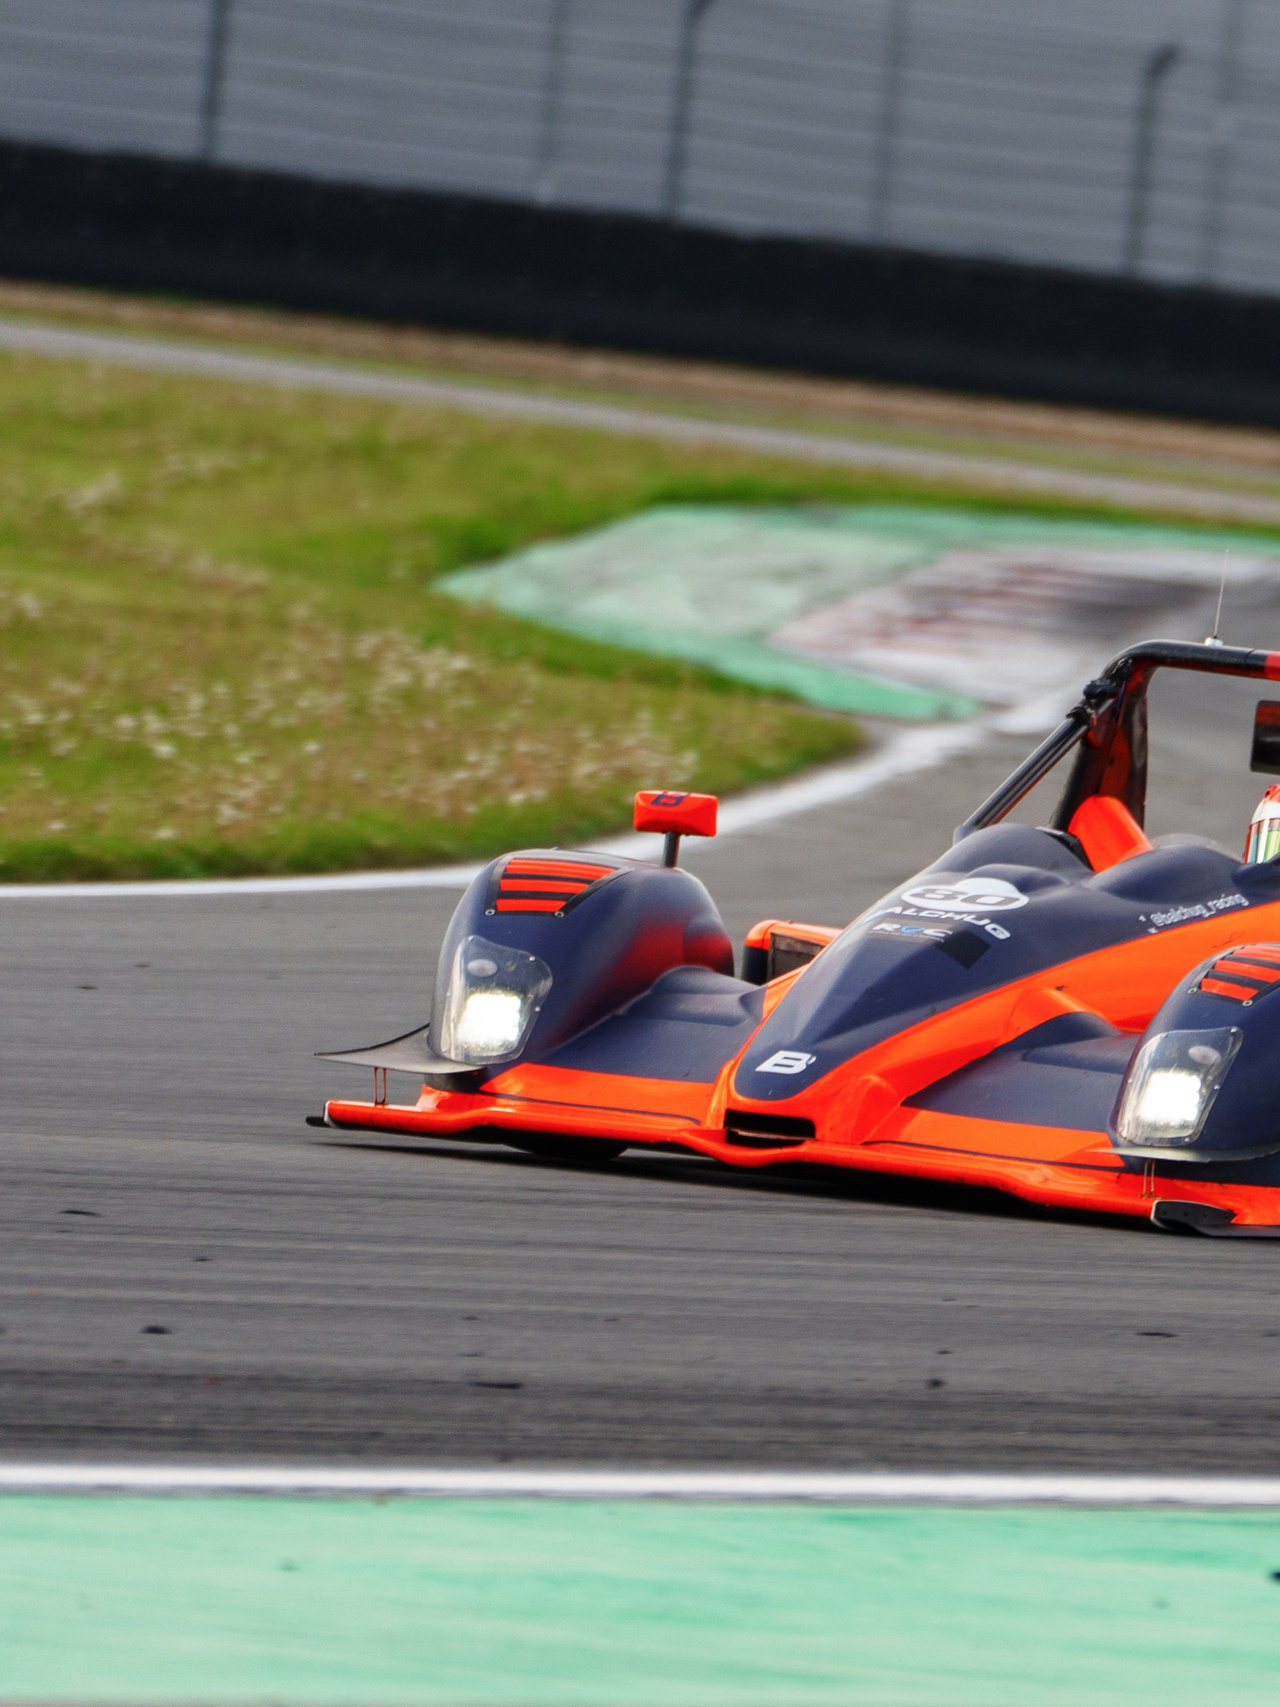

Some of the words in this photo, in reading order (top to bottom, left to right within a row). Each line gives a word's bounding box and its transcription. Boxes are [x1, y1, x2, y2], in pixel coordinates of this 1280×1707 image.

[908, 887, 1022, 908] 80
[1149, 893, 1250, 927] @balchug_racing
[864, 906, 1012, 940] ALCHUG
